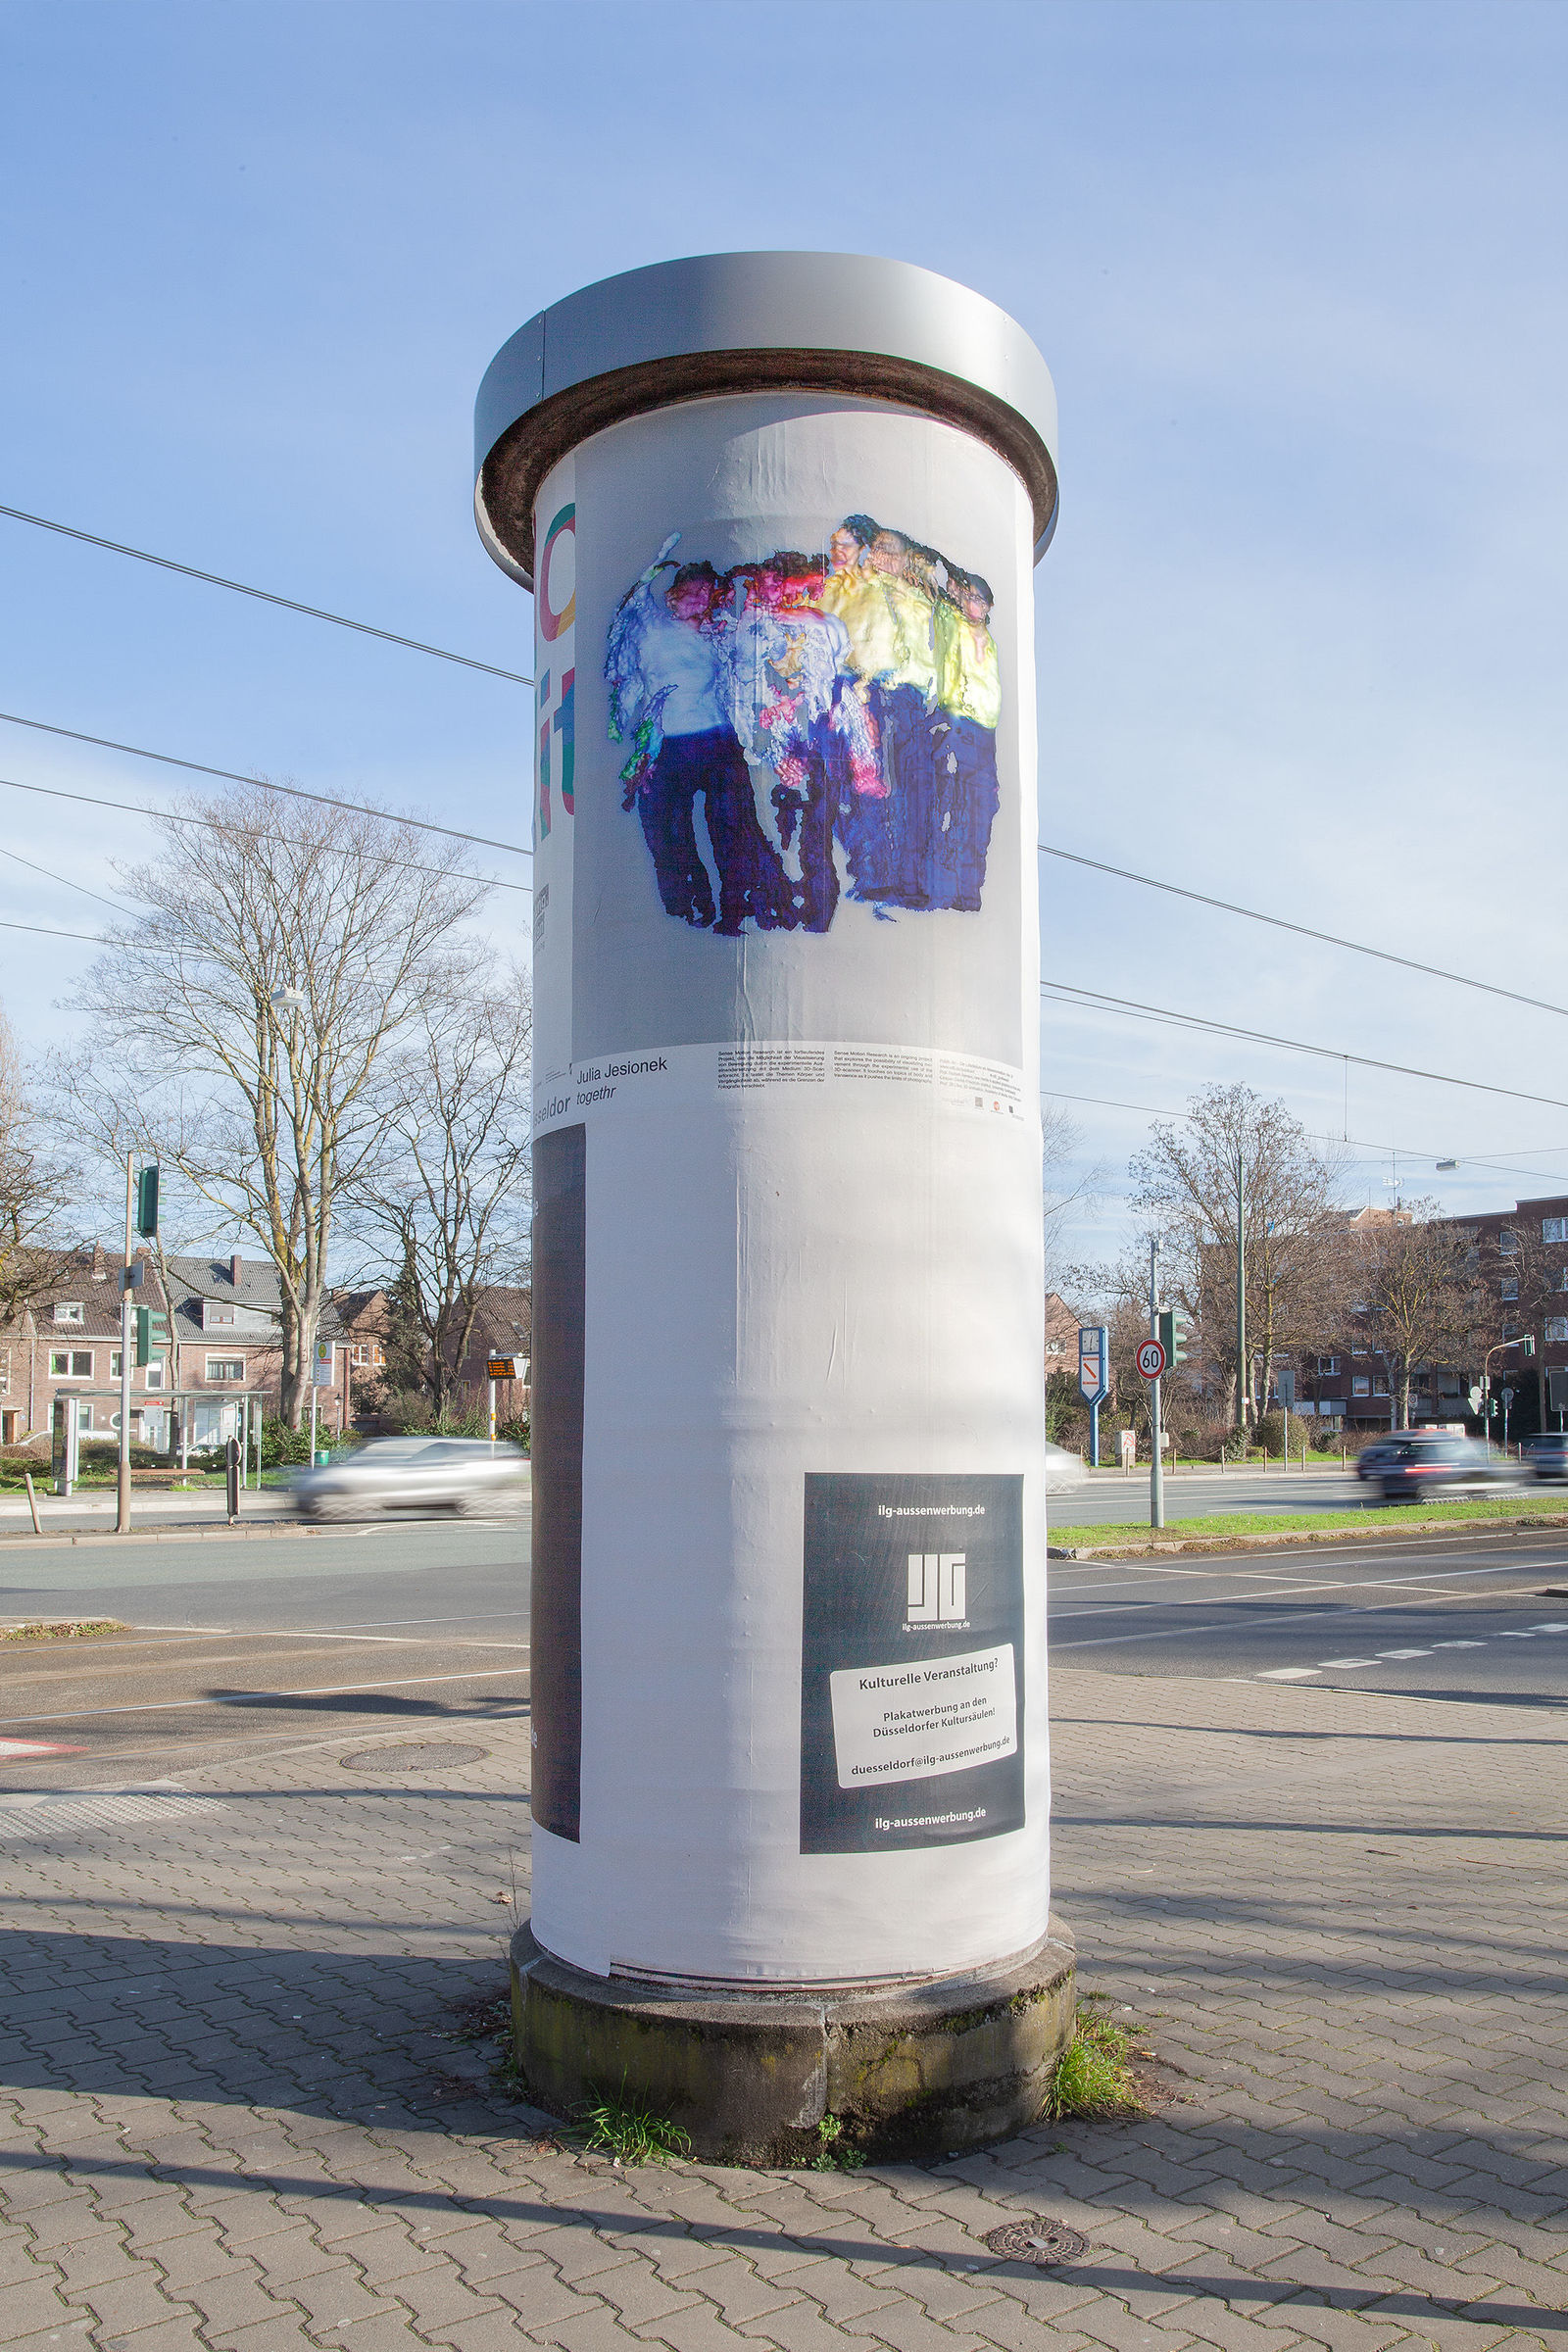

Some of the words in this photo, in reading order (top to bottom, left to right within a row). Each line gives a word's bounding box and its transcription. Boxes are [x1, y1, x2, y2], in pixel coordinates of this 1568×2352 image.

[577, 1067, 601, 1085] Julia
[604, 1056, 668, 1078] Jesionek
[576, 1086, 617, 1106] togethr
[1143, 1350, 1159, 1368] 60
[877, 1504, 986, 1518] ilg-aussenwerbung.de
[902, 1620, 971, 1632] ilg-aussenwerbung.de
[858, 1671, 921, 1690] Kulturelle
[923, 1657, 999, 1682] Veranstaltung?
[883, 1703, 958, 1722] Plakatwerbung
[959, 1701, 971, 1710] an
[972, 1696, 987, 1707] den
[873, 1720, 940, 1738] Düsseldorfer
[941, 1707, 996, 1728] Kultursäulen!
[851, 1736, 1010, 1776] duesseldorf@ilg-aussenwerbung.de
[875, 1807, 987, 1831] ilg-aussenwerbung.de
